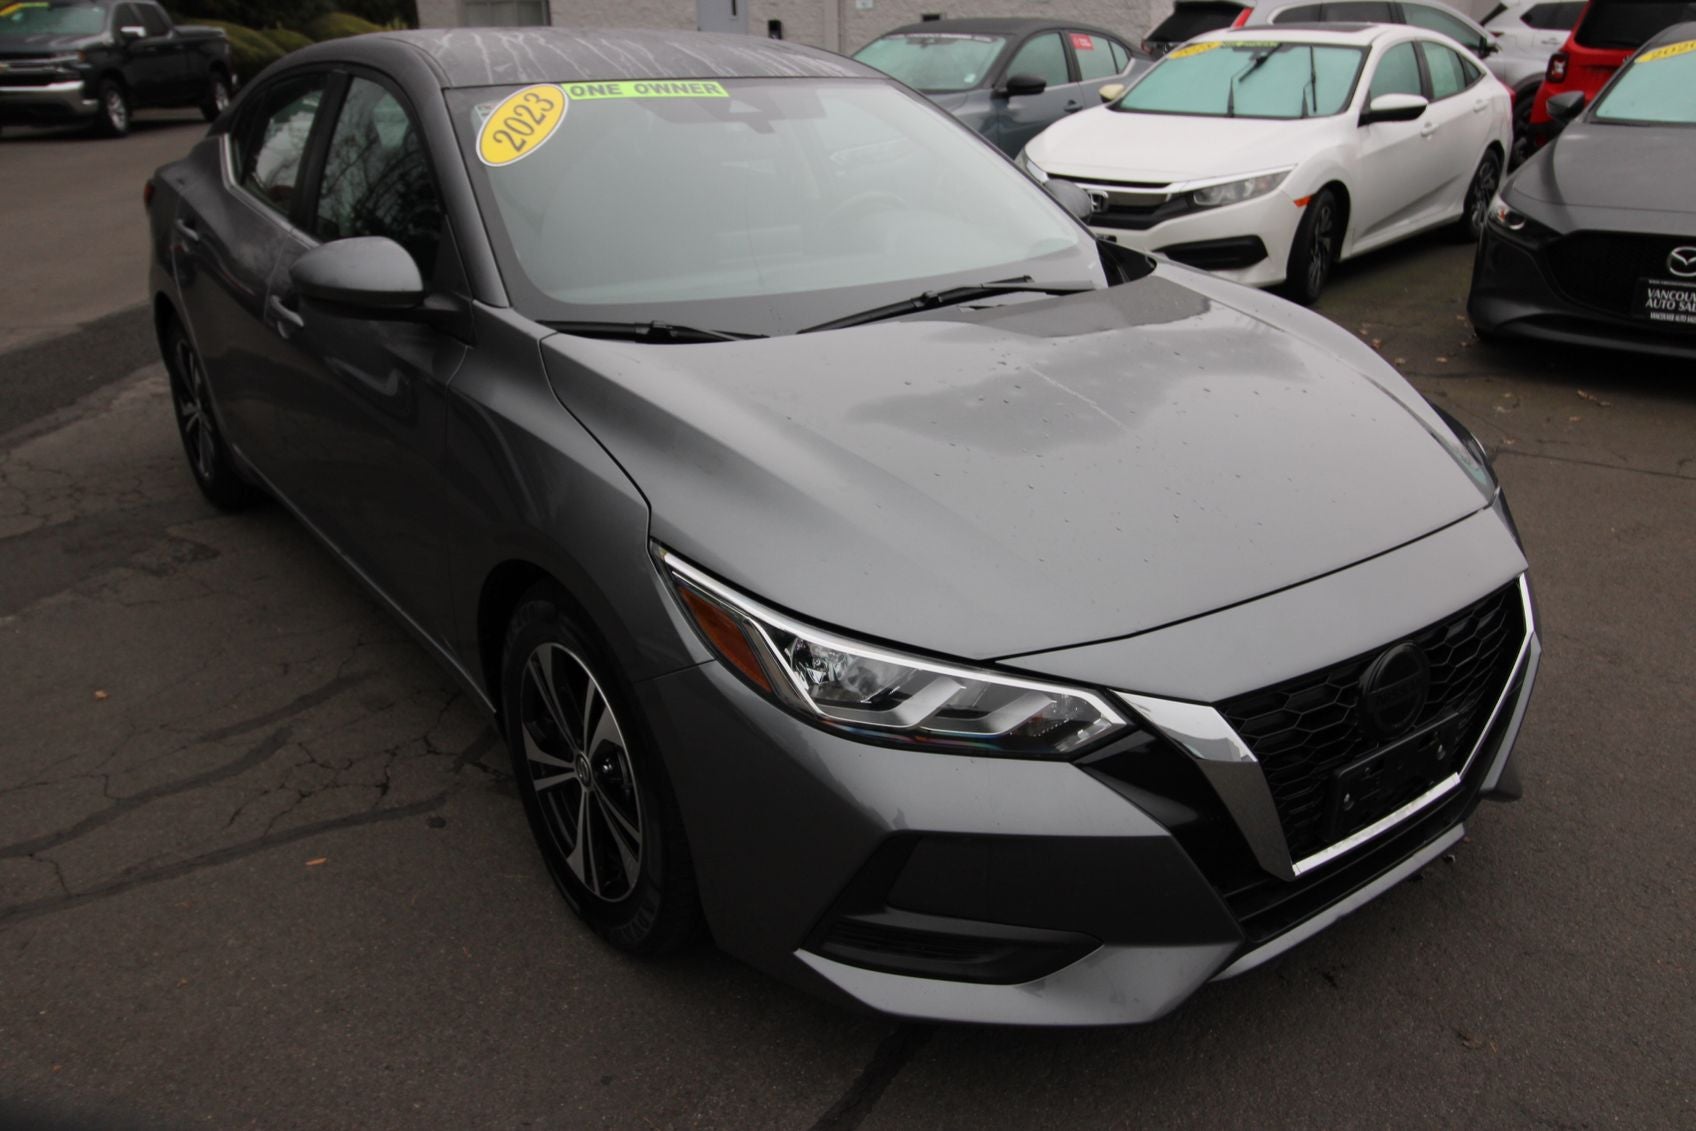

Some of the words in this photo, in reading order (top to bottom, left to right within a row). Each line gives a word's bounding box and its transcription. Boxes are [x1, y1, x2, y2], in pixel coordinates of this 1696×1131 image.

[570, 83, 623, 97] ONE
[633, 82, 722, 96] OWNER
[492, 92, 554, 153] 2023
[1645, 298, 1676, 310] AUTO
